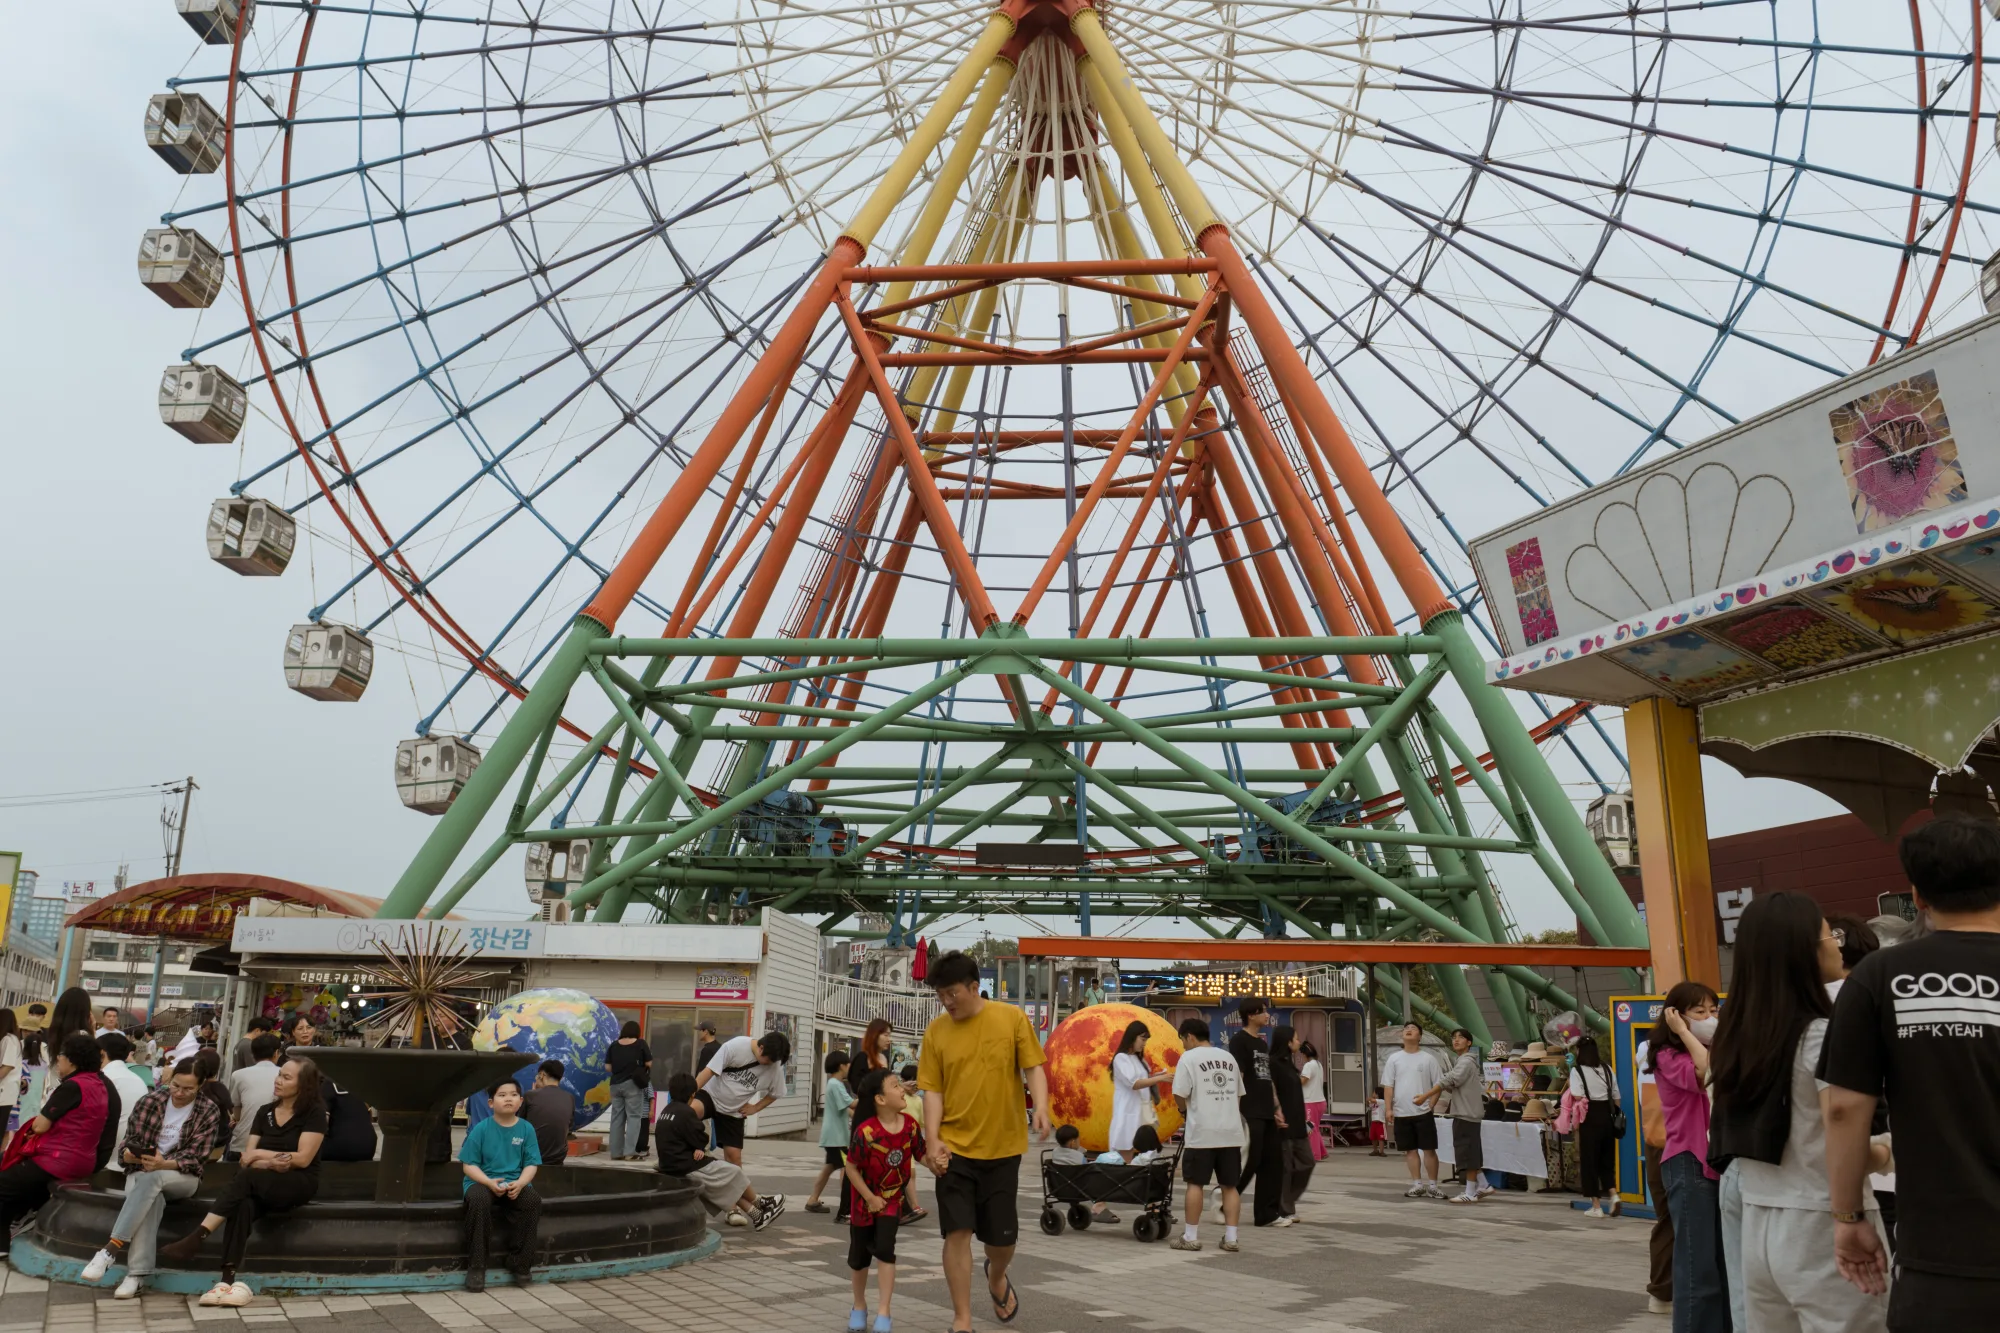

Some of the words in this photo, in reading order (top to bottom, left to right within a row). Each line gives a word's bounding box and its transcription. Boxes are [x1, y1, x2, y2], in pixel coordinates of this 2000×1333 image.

[470, 926, 532, 950] 장난감
[1891, 972, 1999, 998] GOOD
[1942, 1023, 1983, 1038] YEAH
[1199, 1060, 1234, 1072] UMBRO
